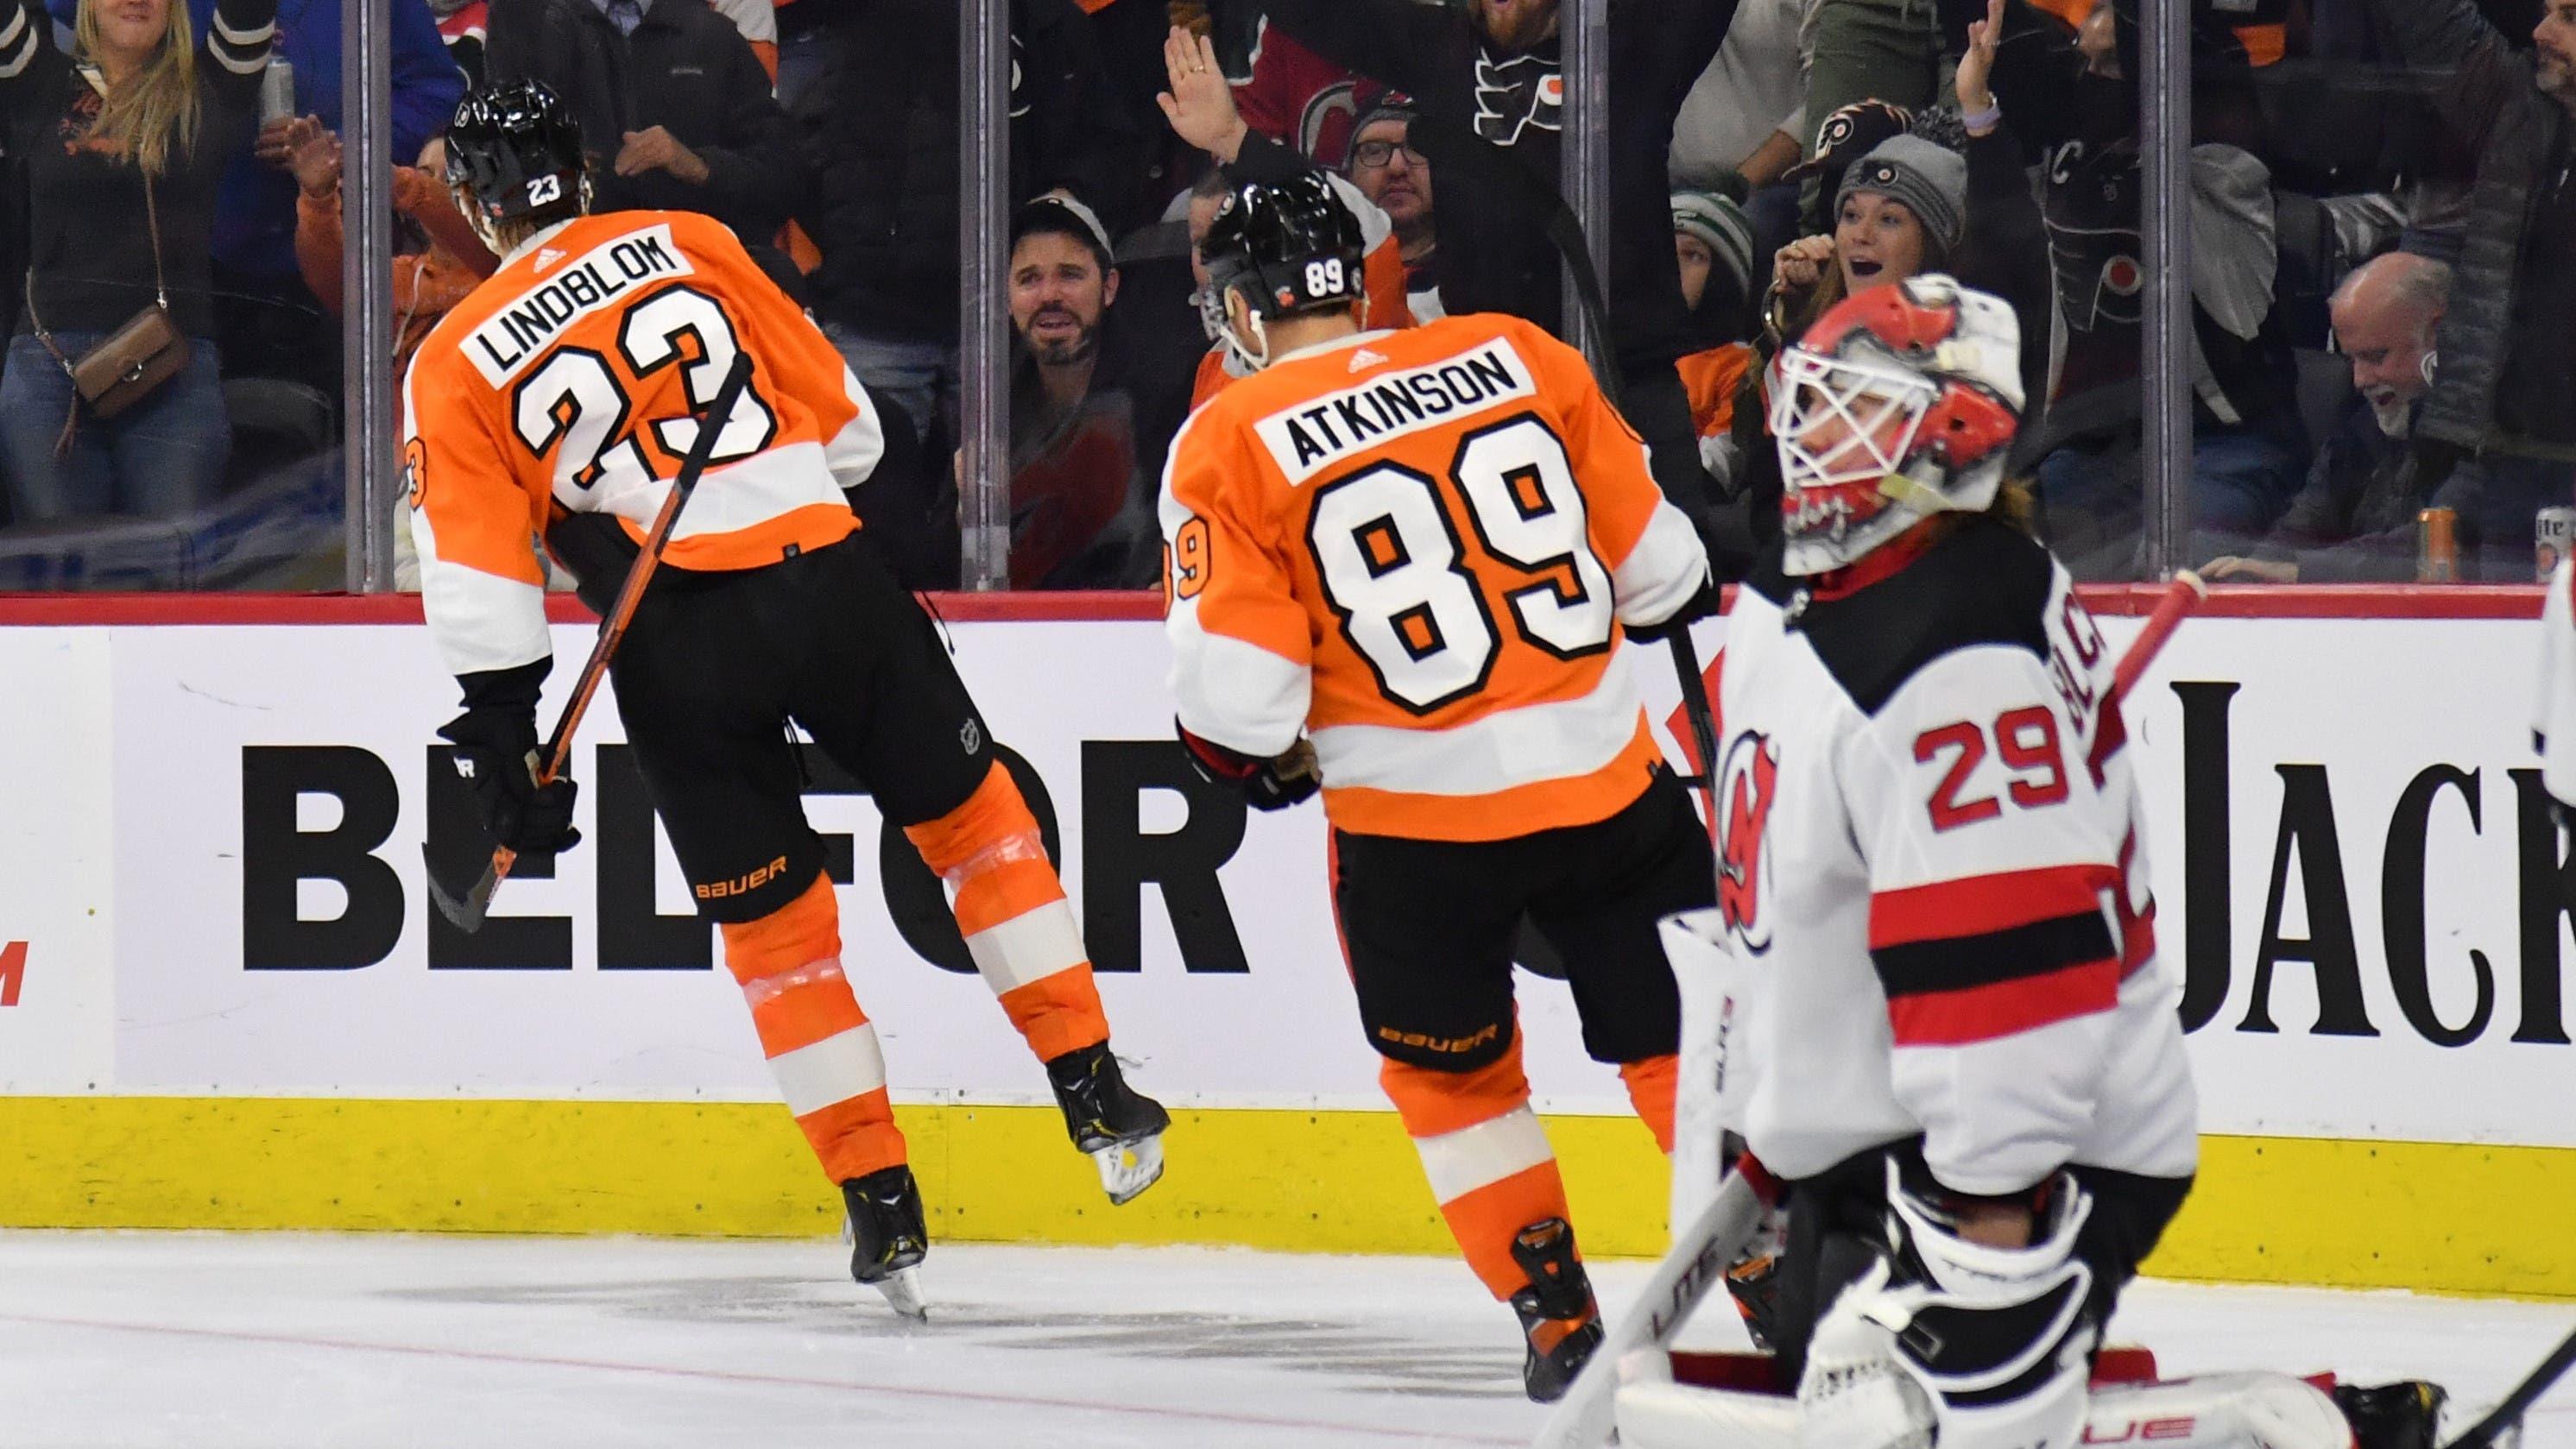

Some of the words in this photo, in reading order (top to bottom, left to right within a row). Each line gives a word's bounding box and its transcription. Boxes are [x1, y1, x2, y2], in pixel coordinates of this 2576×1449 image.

[526, 174, 561, 207] 23
[477, 236, 677, 372] LINDBLOM
[1305, 258, 1344, 298] 89
[512, 283, 778, 515] 23
[1285, 350, 1517, 468] ATKINSON
[1304, 410, 1614, 716] 89
[1913, 704, 2070, 833] 29
[696, 855, 787, 898] BAUER
[1380, 1023, 1499, 1052] BAUER
